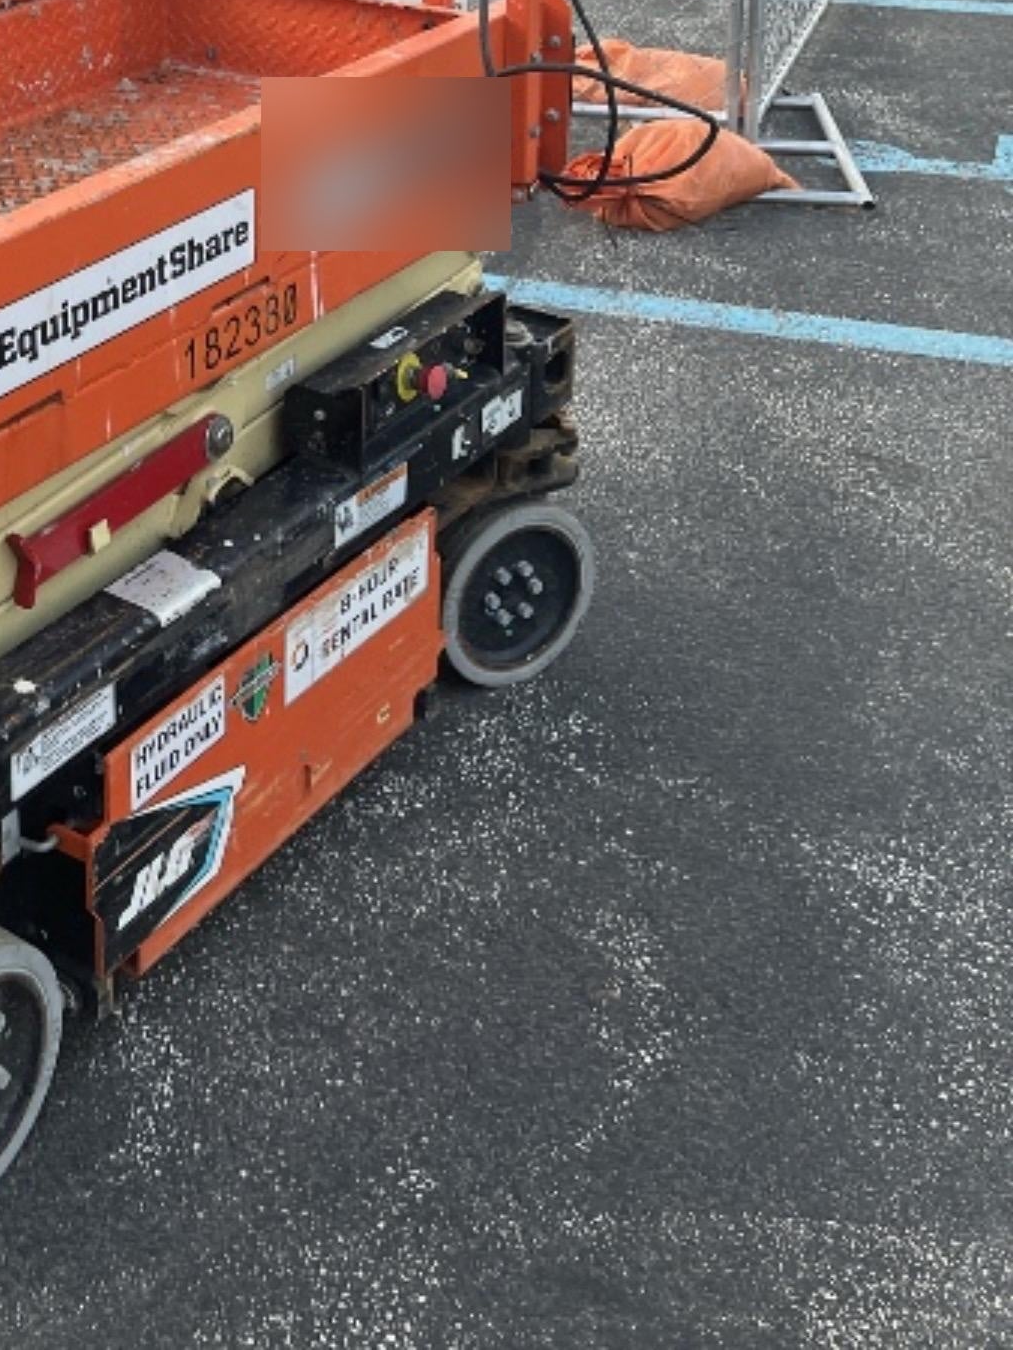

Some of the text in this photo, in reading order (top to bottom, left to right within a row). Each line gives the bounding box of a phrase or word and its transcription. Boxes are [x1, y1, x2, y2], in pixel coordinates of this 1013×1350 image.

[184, 282, 297, 379] 182380
[135, 683, 223, 766] HYDRAULIC
[135, 748, 181, 799] FLUID
